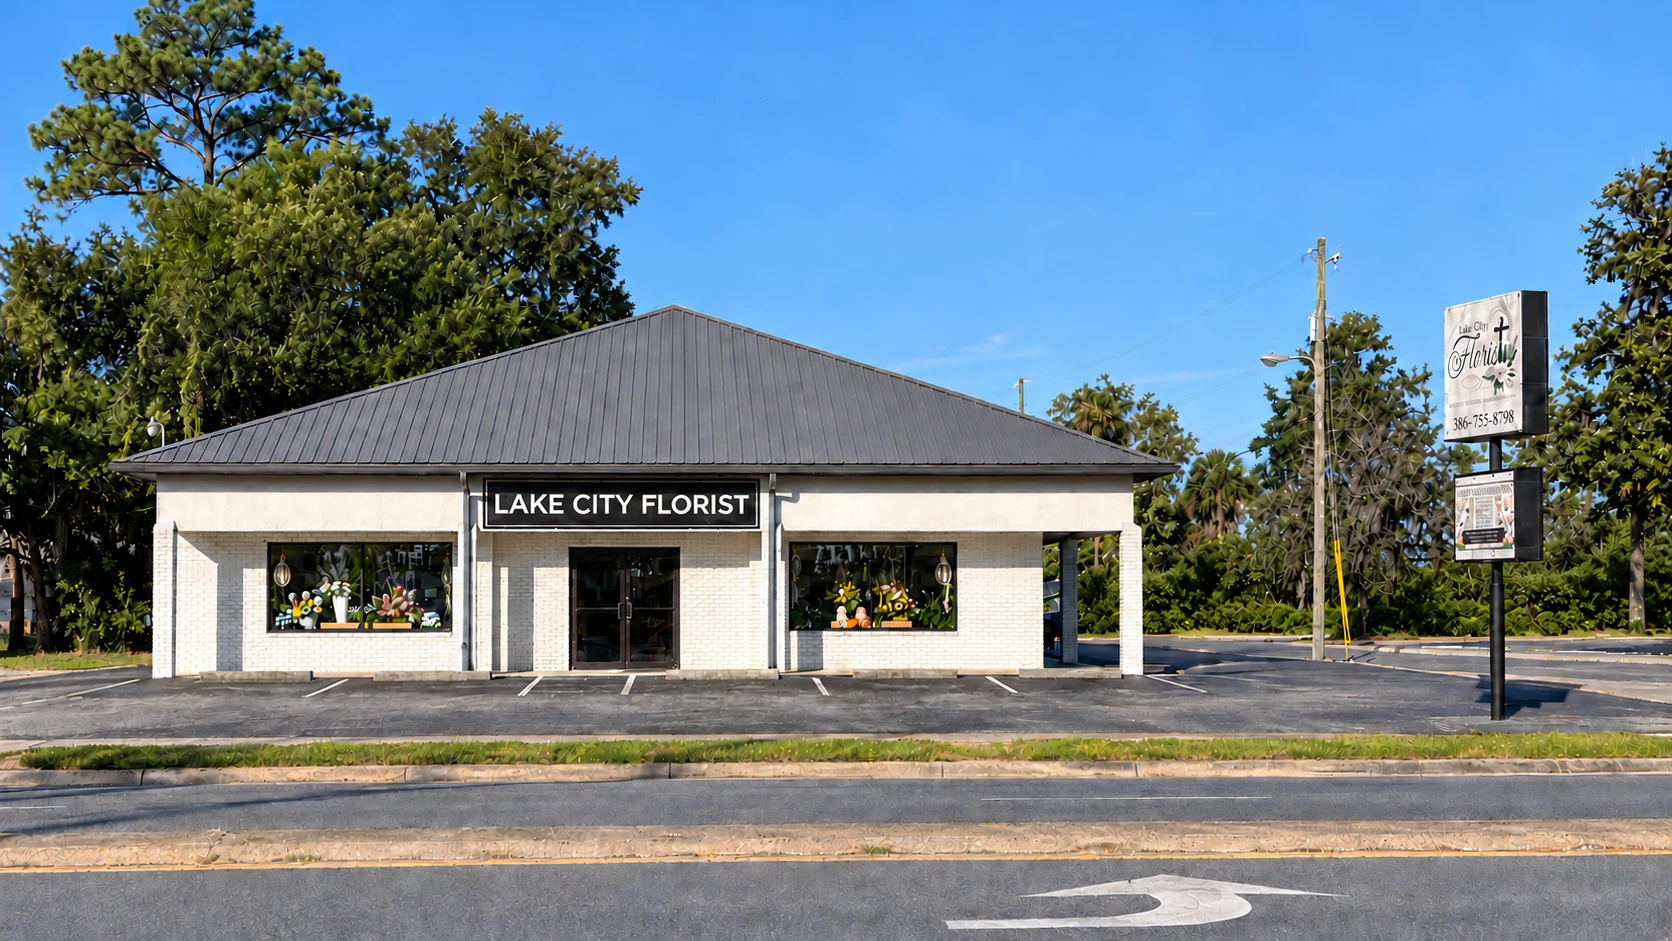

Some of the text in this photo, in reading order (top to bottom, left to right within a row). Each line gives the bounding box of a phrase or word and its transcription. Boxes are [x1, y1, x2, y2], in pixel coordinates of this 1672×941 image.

[1453, 409, 1515, 432] 386-755-8798
[494, 493, 750, 515] LAKE CITY FLORIST
